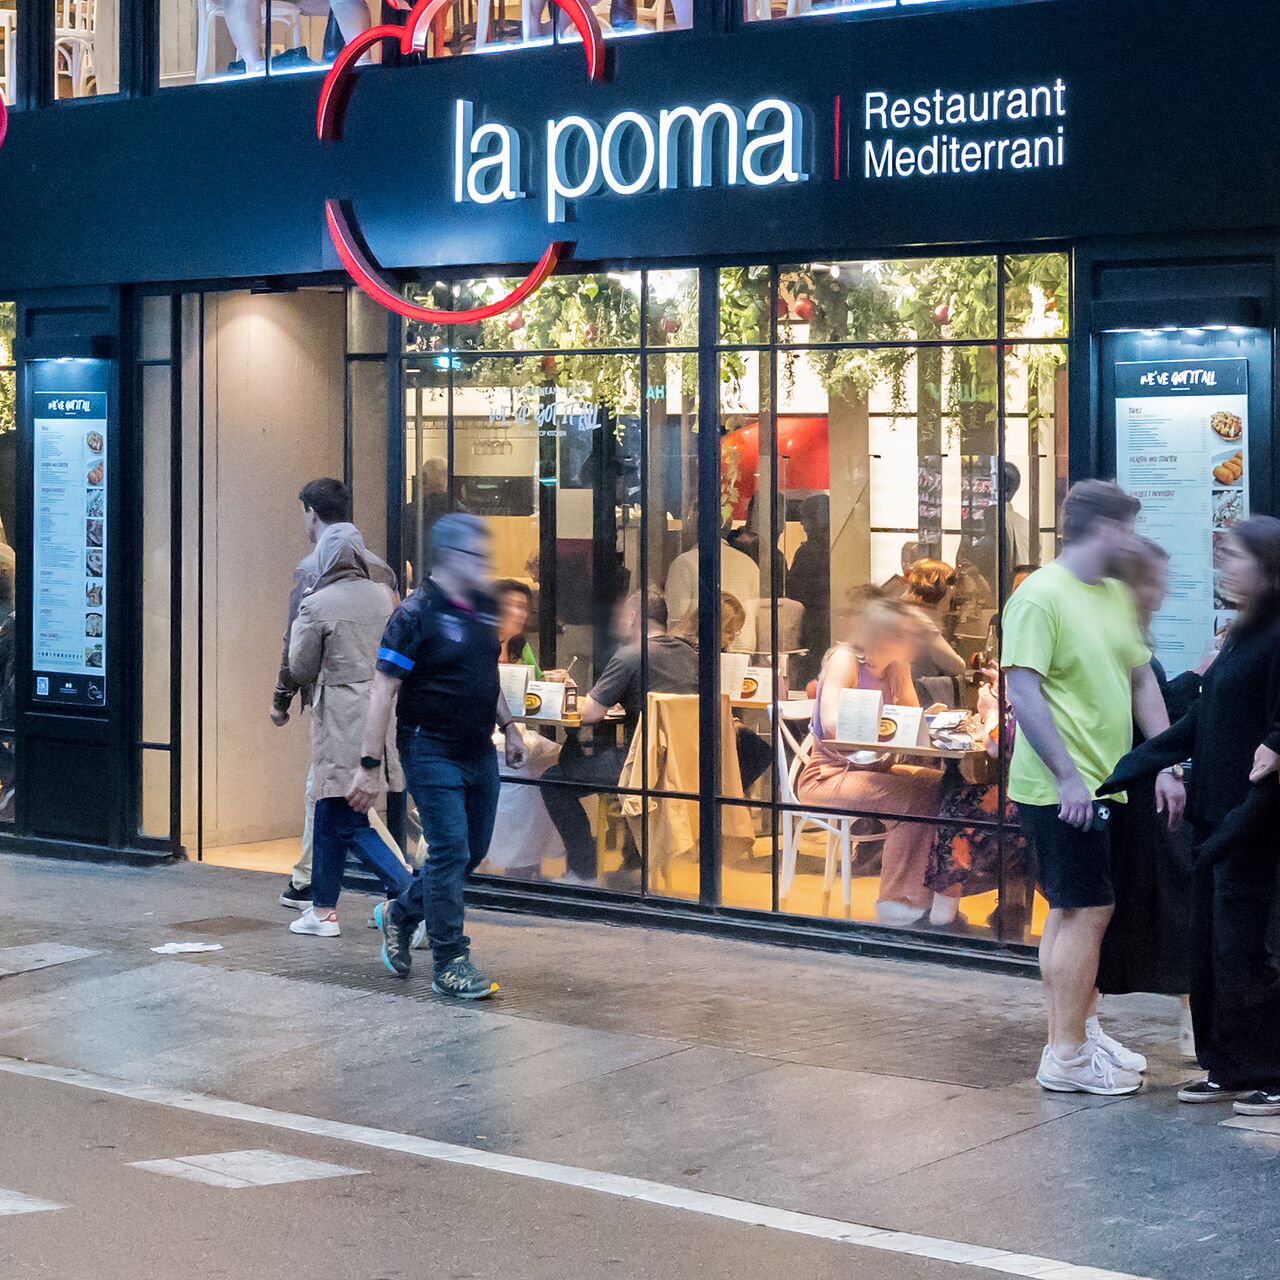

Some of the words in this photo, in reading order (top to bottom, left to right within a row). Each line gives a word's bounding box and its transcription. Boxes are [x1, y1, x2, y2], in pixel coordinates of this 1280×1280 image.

[862, 77, 1067, 132] Restaurant
[453, 98, 518, 204] la
[546, 98, 806, 224] poma
[862, 124, 1066, 180] Mediterrani
